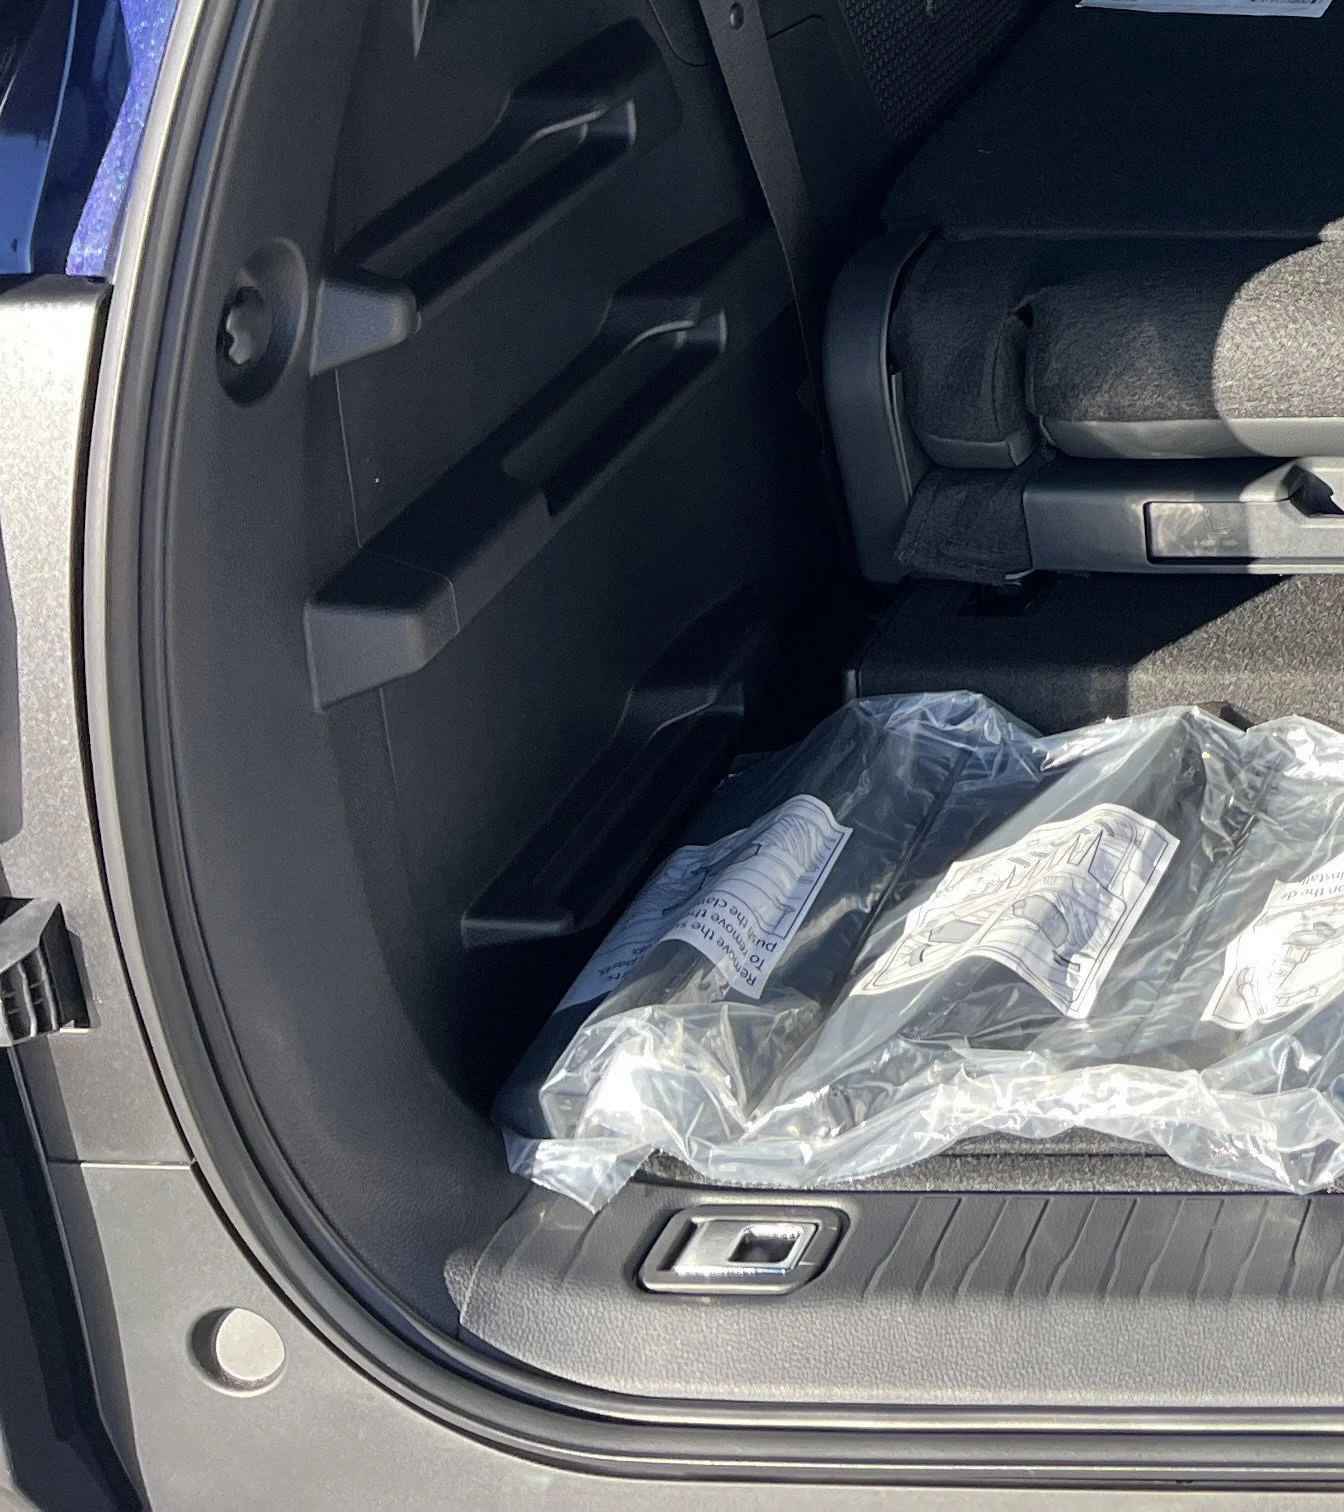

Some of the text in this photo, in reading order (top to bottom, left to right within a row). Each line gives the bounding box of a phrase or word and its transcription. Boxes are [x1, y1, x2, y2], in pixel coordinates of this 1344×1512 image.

[1301, 888, 1324, 898] the
[729, 905, 749, 929] the
[691, 920, 716, 941] the
[710, 912, 750, 959] remove
[747, 926, 779, 954] push
[716, 936, 759, 987] Remove
[750, 954, 766, 973] To
